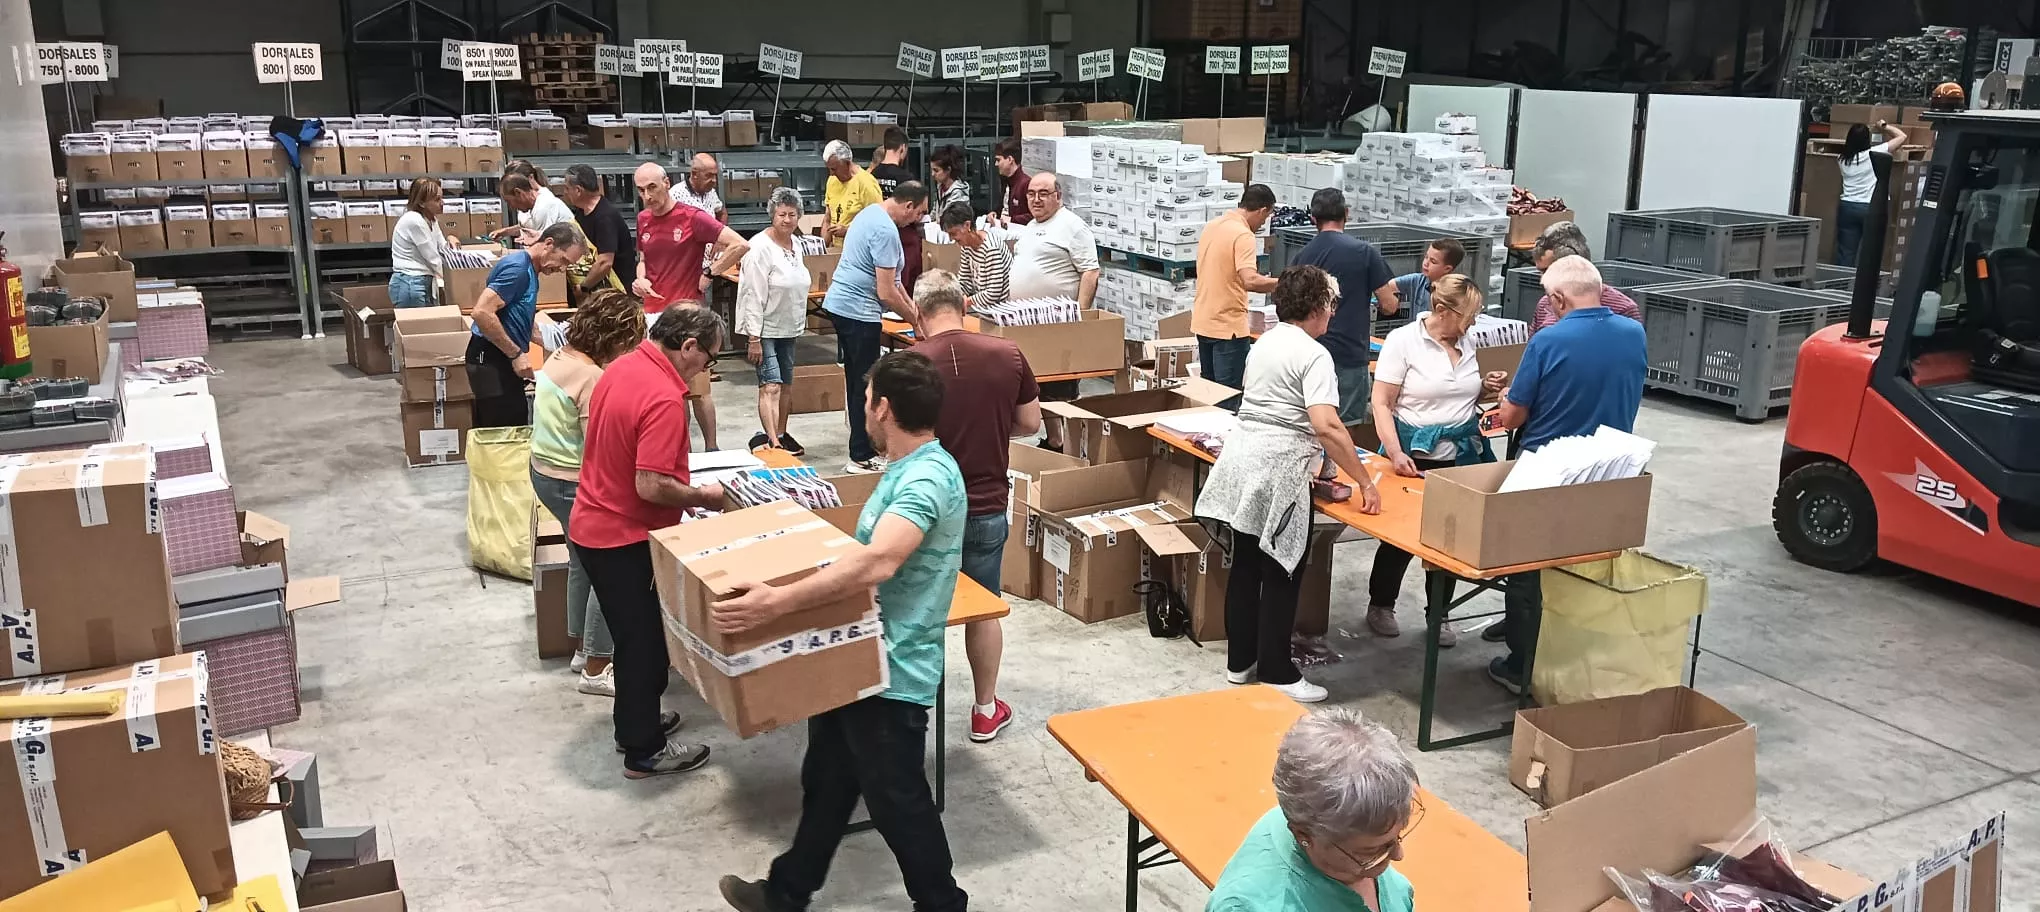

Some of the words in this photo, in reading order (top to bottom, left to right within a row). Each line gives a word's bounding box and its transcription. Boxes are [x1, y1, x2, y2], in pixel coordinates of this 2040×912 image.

[38, 48, 97, 60] DORSALES
[261, 47, 314, 59] DORSALES
[466, 48, 486, 58] 8501
[494, 47, 514, 58] 9000
[600, 48, 636, 60] DORSALE
[600, 61, 615, 71] 1501
[640, 56, 658, 67] 5501
[673, 54, 693, 65] 9001
[699, 55, 720, 66] 9500
[75, 64, 100, 76] 8000
[262, 63, 284, 75] 8001
[293, 64, 316, 75] 8500
[680, 66, 695, 74] PARL
[1915, 473, 1957, 501] 25
